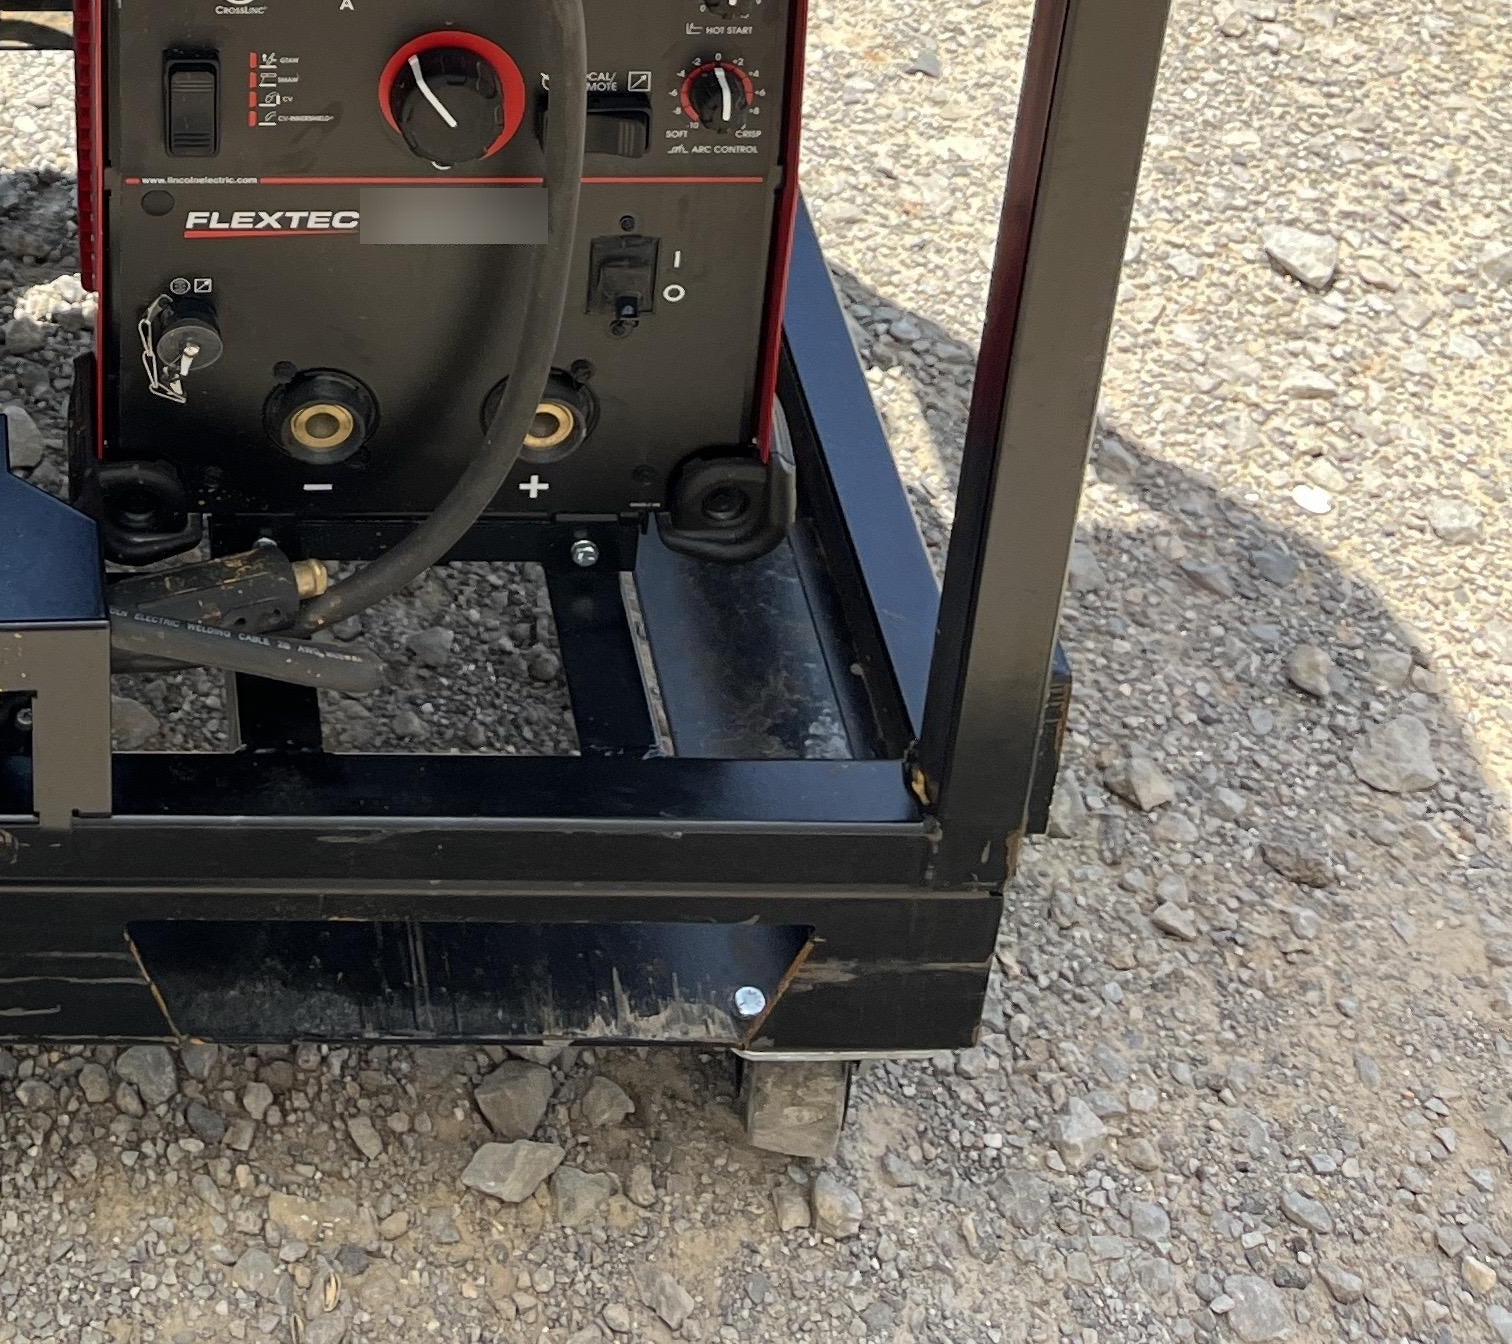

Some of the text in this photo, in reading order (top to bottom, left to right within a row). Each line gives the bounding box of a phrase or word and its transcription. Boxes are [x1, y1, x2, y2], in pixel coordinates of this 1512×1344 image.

[706, 26, 724, 34] HOT
[587, 82, 617, 92] MOTE
[666, 130, 687, 138] SOFT
[735, 130, 761, 138] CRISP
[142, 176, 257, 185] www.lincolnelectric.com
[186, 211, 360, 229] FLEXTEC
